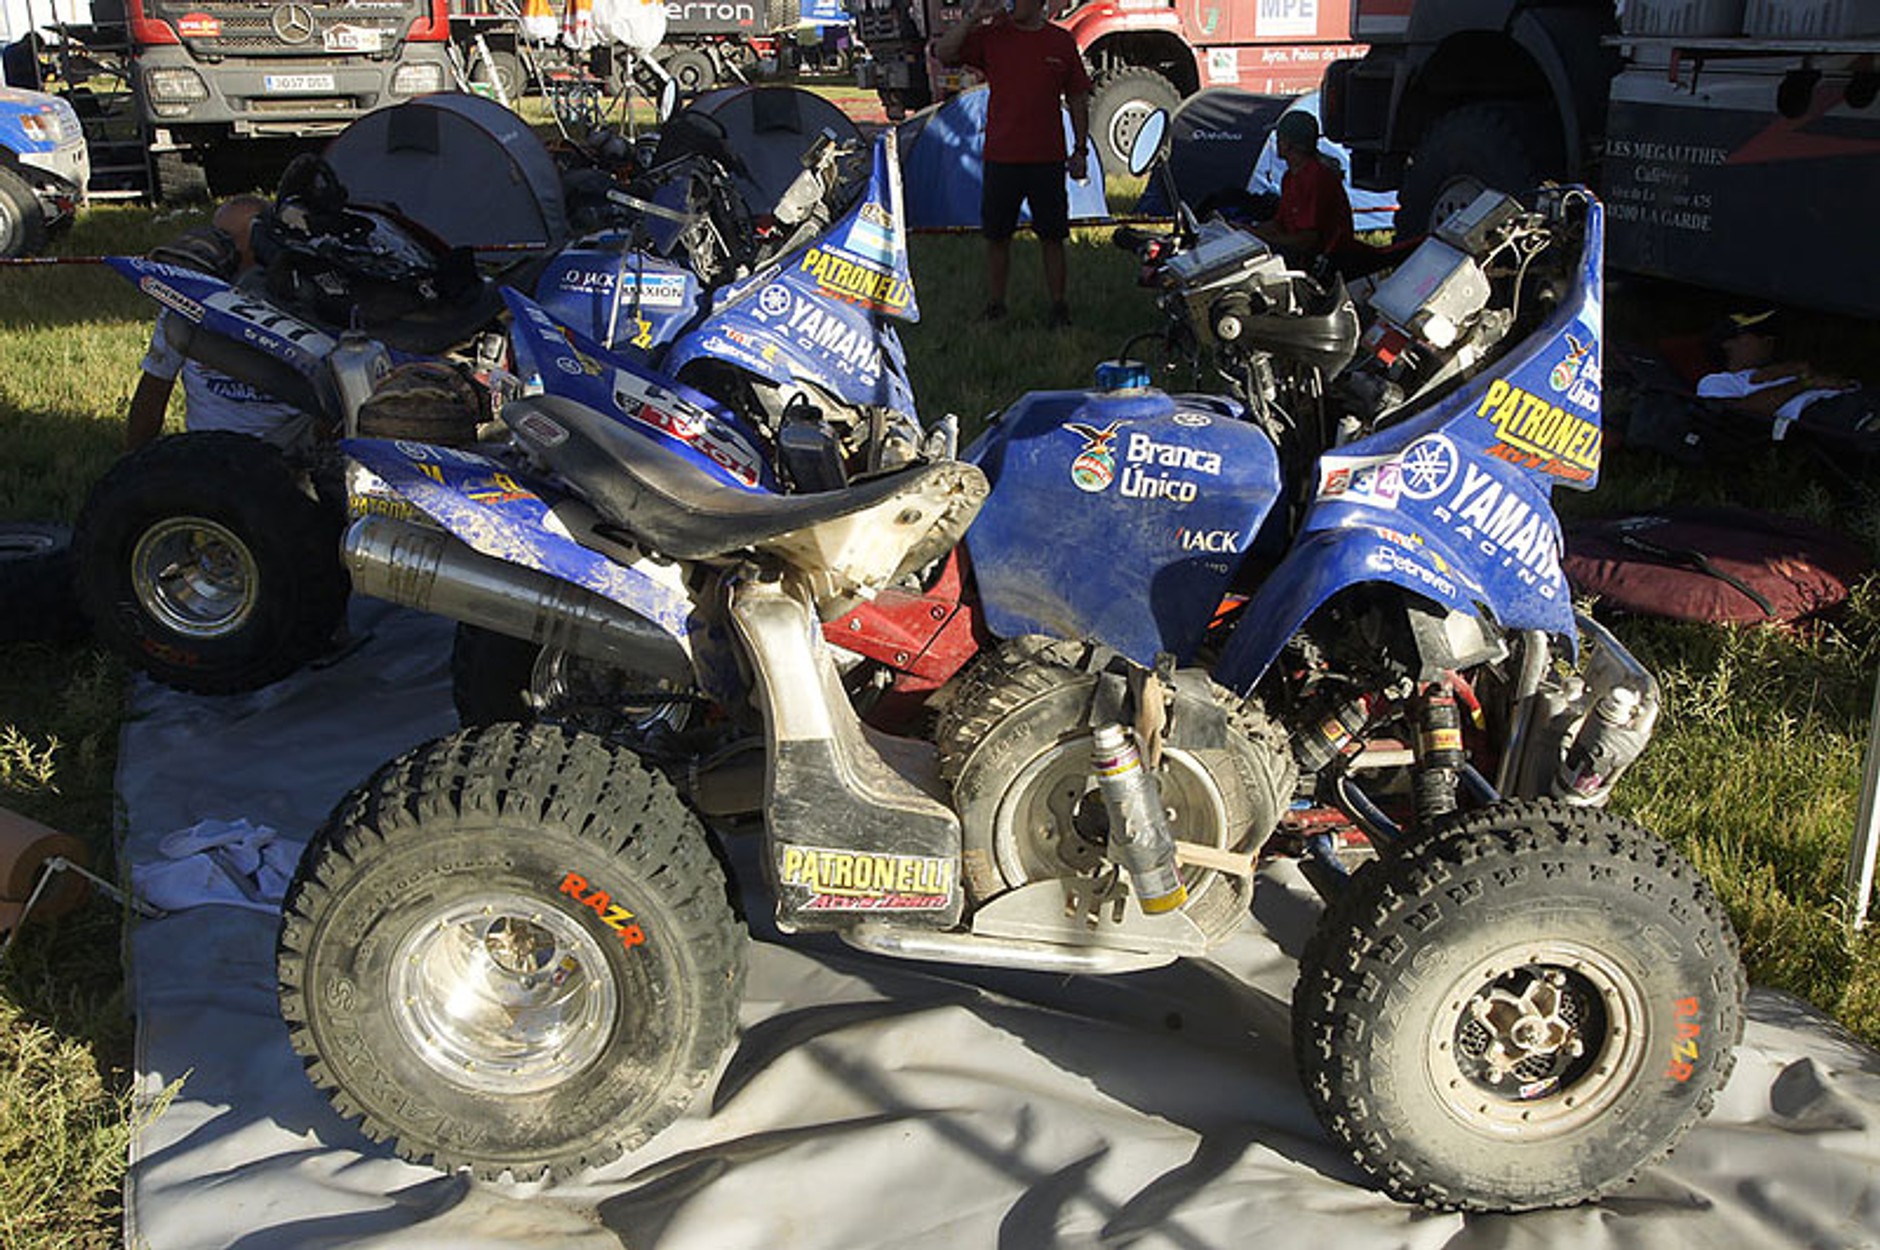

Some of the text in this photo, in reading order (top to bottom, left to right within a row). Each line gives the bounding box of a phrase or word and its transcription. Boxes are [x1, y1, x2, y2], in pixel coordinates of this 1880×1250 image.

[787, 297, 882, 379] YAMAHA
[1119, 463, 1198, 502] Único
[1126, 432, 1222, 476] Branca
[1432, 506, 1558, 599] RACING
[1449, 463, 1563, 589] YAMAHA
[559, 872, 646, 949] RAZR
[784, 849, 950, 897] PATRONELLI
[1665, 996, 1701, 1083] RAZR
